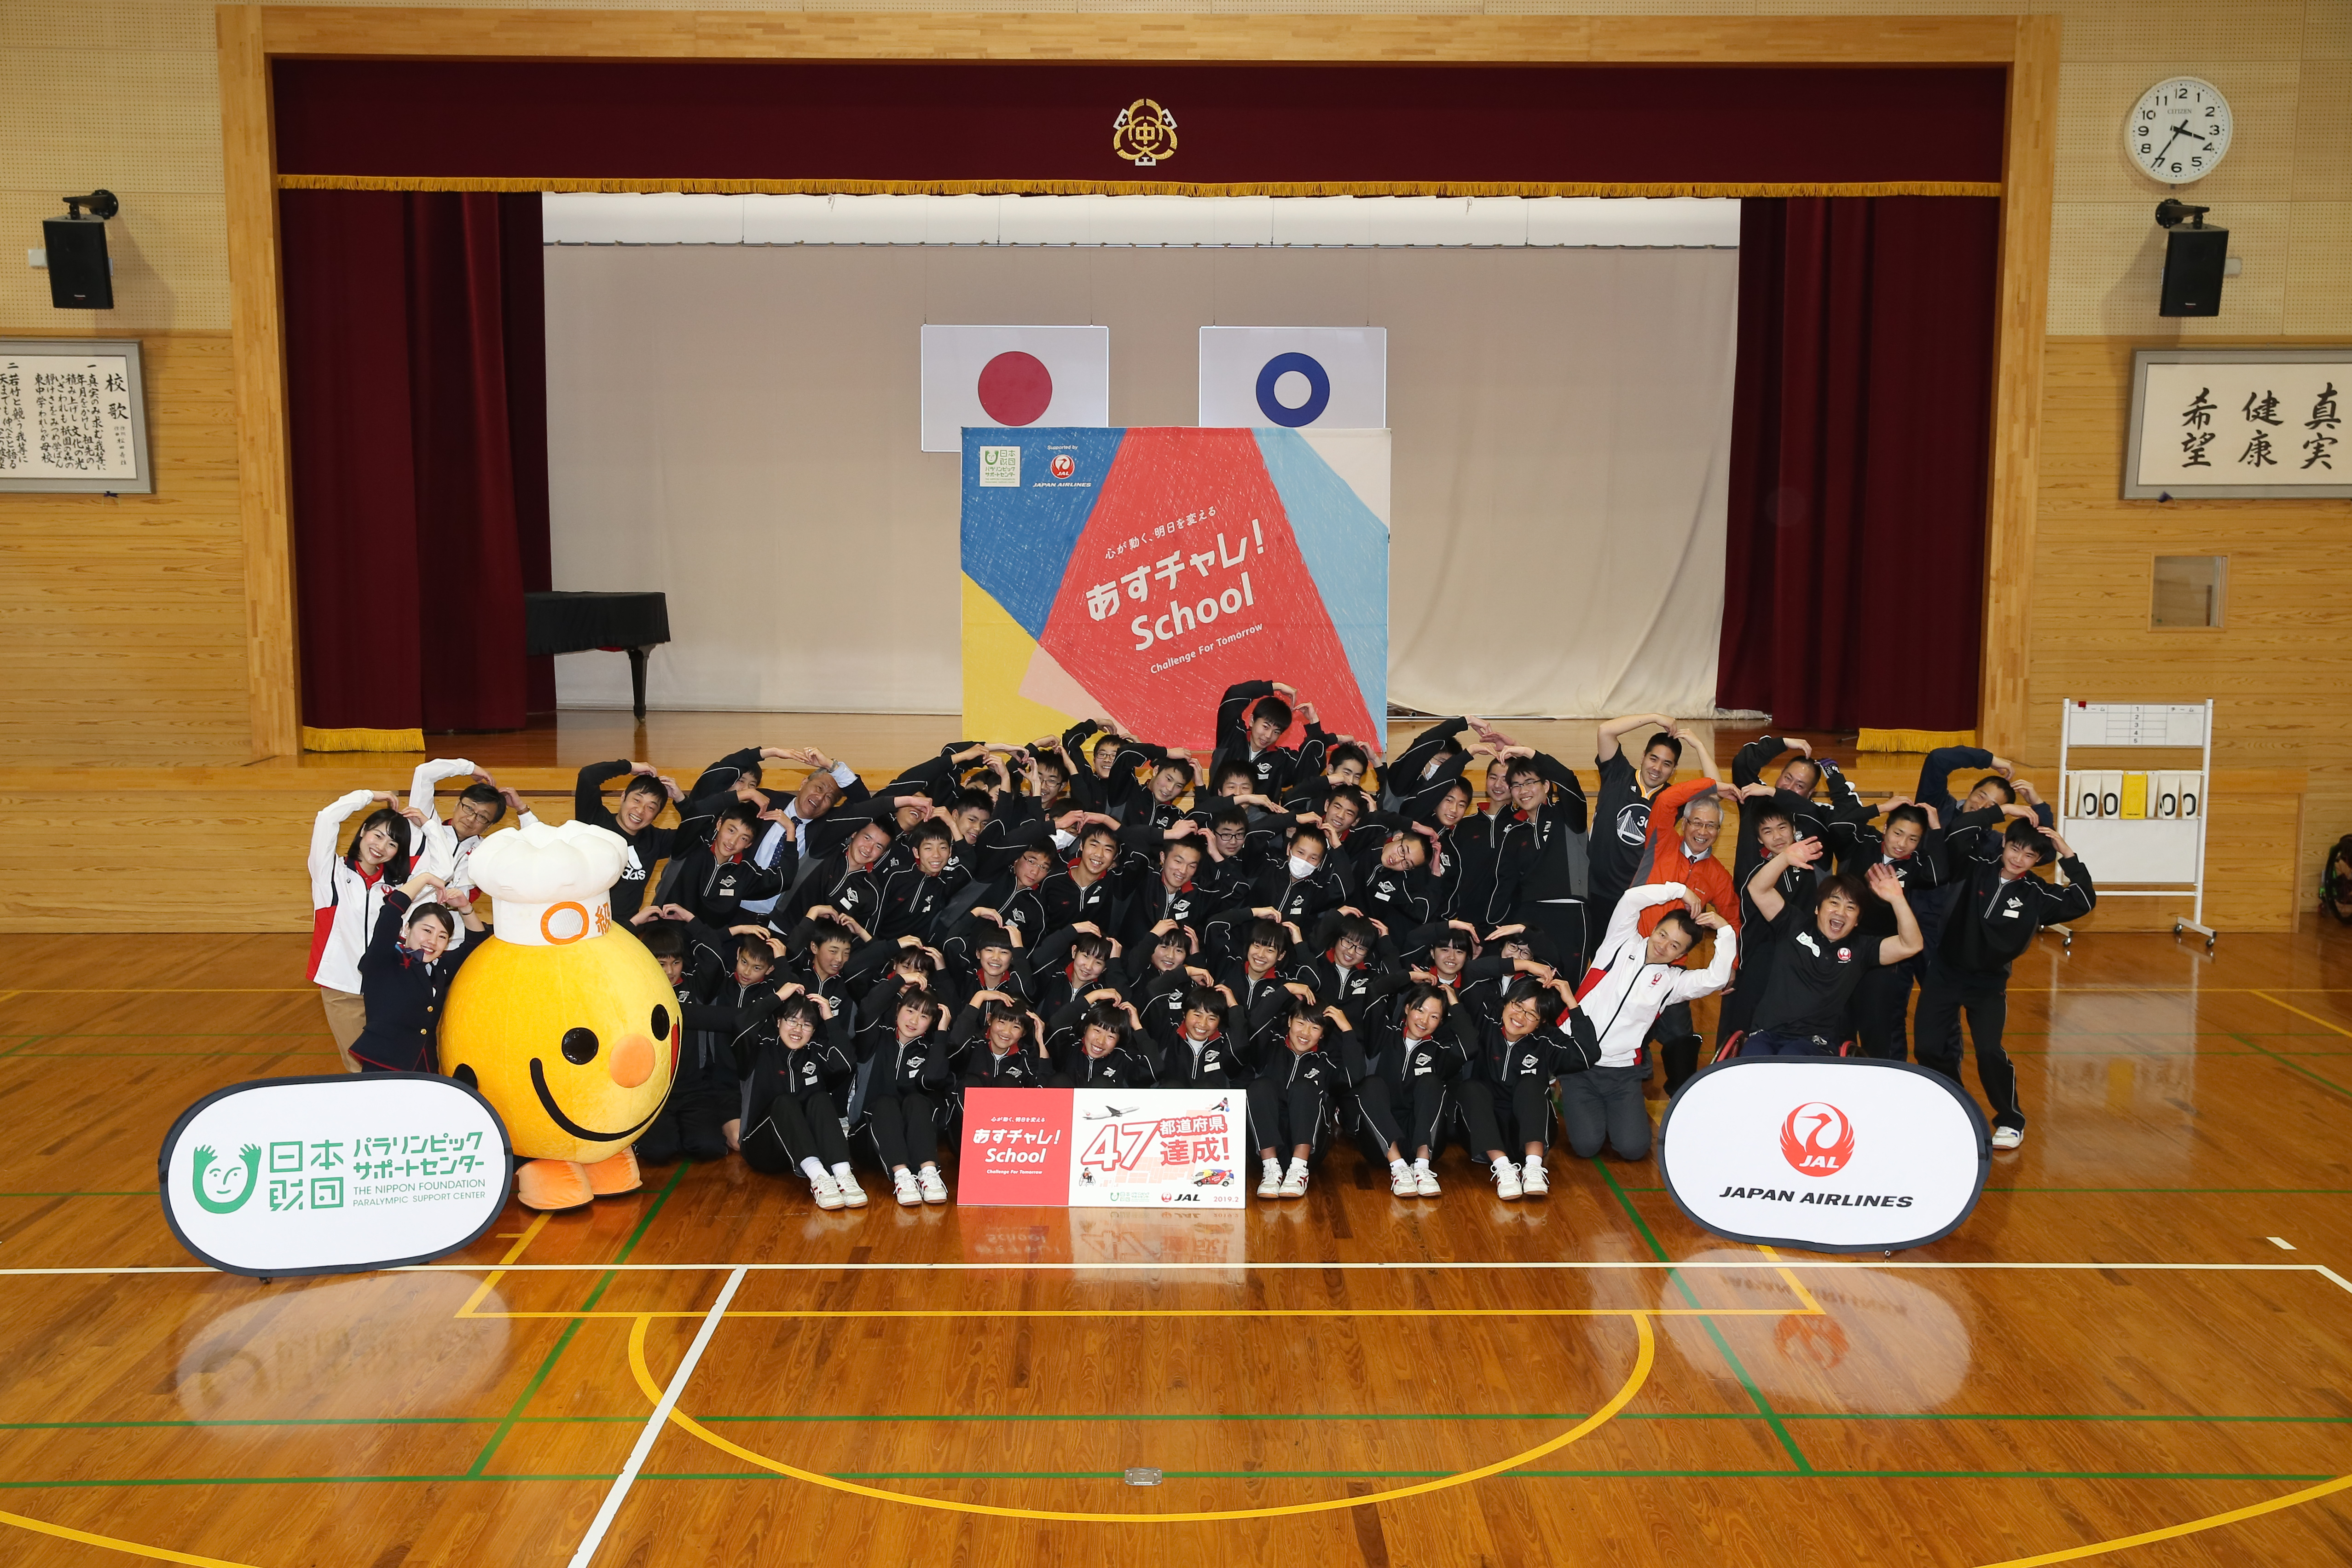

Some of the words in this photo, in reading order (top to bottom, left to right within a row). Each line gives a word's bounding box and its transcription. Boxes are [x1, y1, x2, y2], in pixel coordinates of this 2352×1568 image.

[2156, 96, 2167, 106] 11
[2175, 88, 2188, 98] 12
[2196, 92, 2201, 103] 1
[2142, 110, 2155, 120] 10
[2205, 107, 2214, 117] 2
[1135, 122, 1155, 145] 中
[2138, 126, 2149, 136] 9
[2209, 125, 2220, 135] 3
[2141, 144, 2151, 153] 8
[2202, 143, 2214, 151] 4
[2155, 158, 2165, 168] 7
[2171, 162, 2182, 173] 6
[2191, 156, 2202, 167] 5
[104, 373, 129, 420] 校歌
[2181, 388, 2218, 468] 希望
[2238, 390, 2284, 468] 健康
[2300, 382, 2341, 469] 真実
[1105, 506, 1217, 560] 心が動く、明日を変える
[1130, 571, 1254, 651] School
[1150, 650, 1196, 674] Challenge
[1198, 643, 1214, 655] For
[1216, 623, 1263, 647] Tomorrow
[1159, 1116, 1226, 1137] 都道府県
[353, 1131, 483, 1157] パラリンピック
[1080, 1120, 1162, 1172] 47
[269, 1139, 344, 1174] 日本
[984, 1147, 1047, 1163] School
[1798, 1154, 1840, 1169] JAL
[353, 1155, 485, 1180] サポートセンター
[269, 1176, 344, 1212] 財団
[353, 1186, 372, 1196] THE
[375, 1183, 416, 1195] NIPPON
[419, 1179, 486, 1191] FOUNDATION
[353, 1196, 409, 1207] PARALYMPIC
[412, 1192, 451, 1203] SUPPORT
[453, 1191, 486, 1200] CENTER
[1719, 1186, 1796, 1203] JAPAN
[1799, 1192, 1914, 1208] AIRLINES
